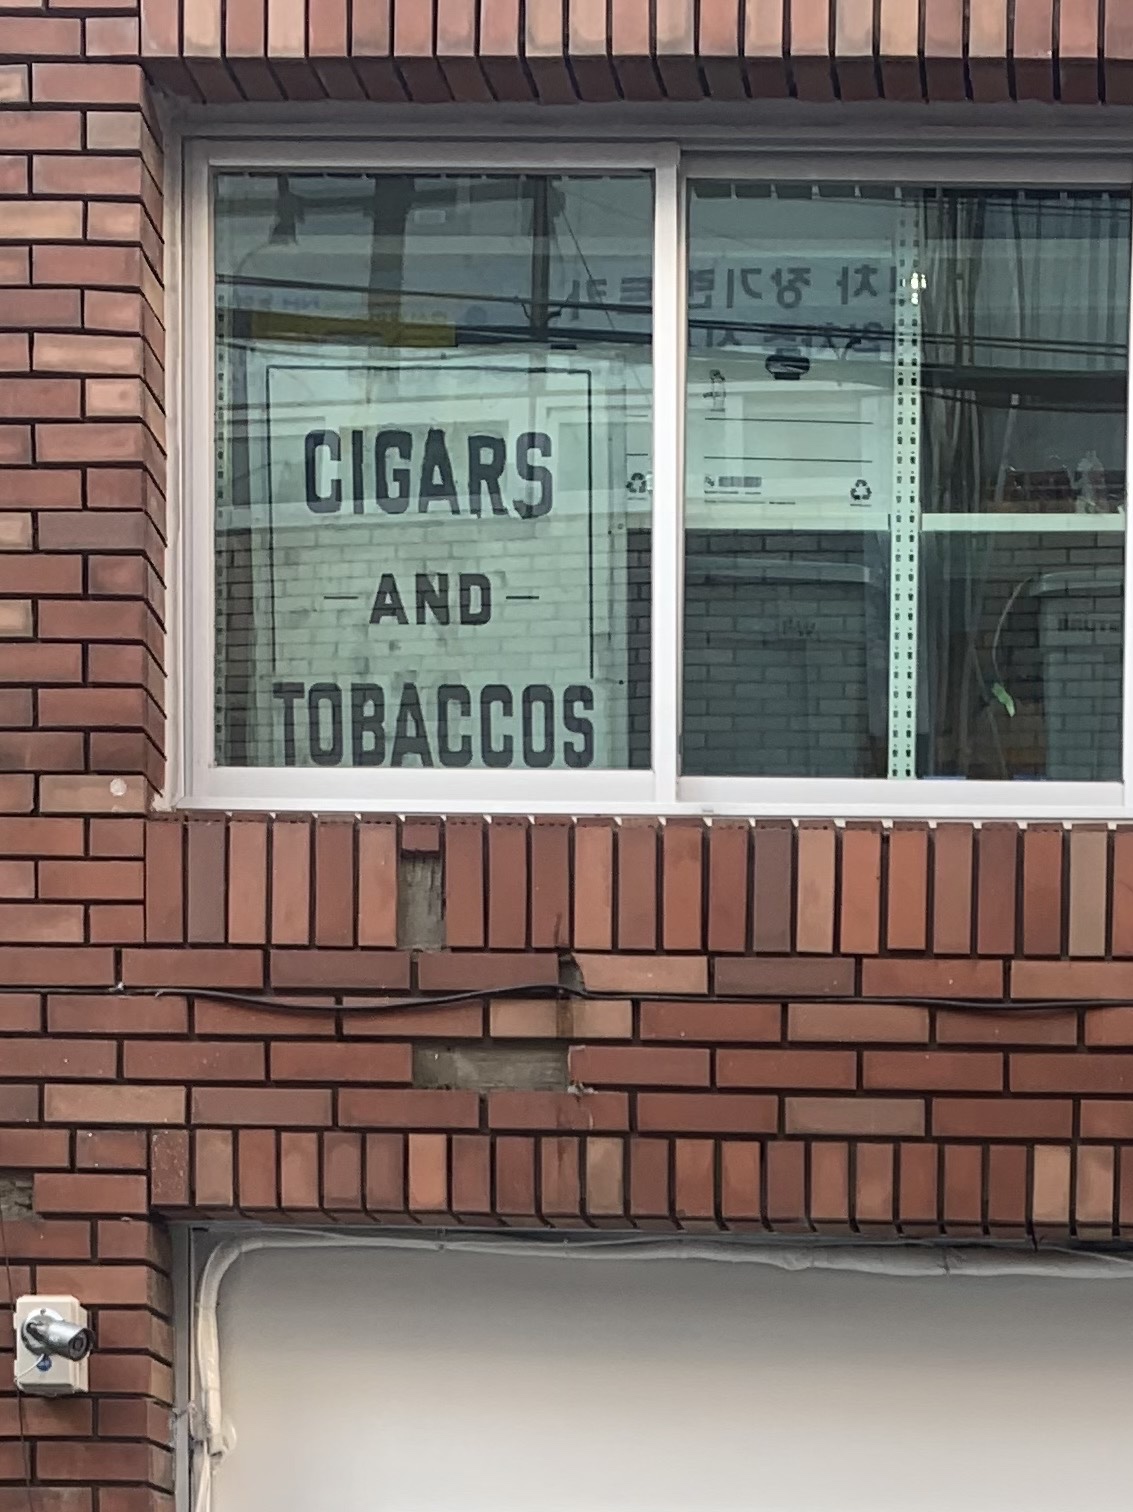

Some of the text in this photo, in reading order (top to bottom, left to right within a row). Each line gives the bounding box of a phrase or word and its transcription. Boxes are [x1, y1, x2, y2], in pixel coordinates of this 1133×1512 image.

[304, 428, 554, 519] CIGARS
[368, 572, 493, 627] AND
[272, 683, 595, 769] TOBACCOS
